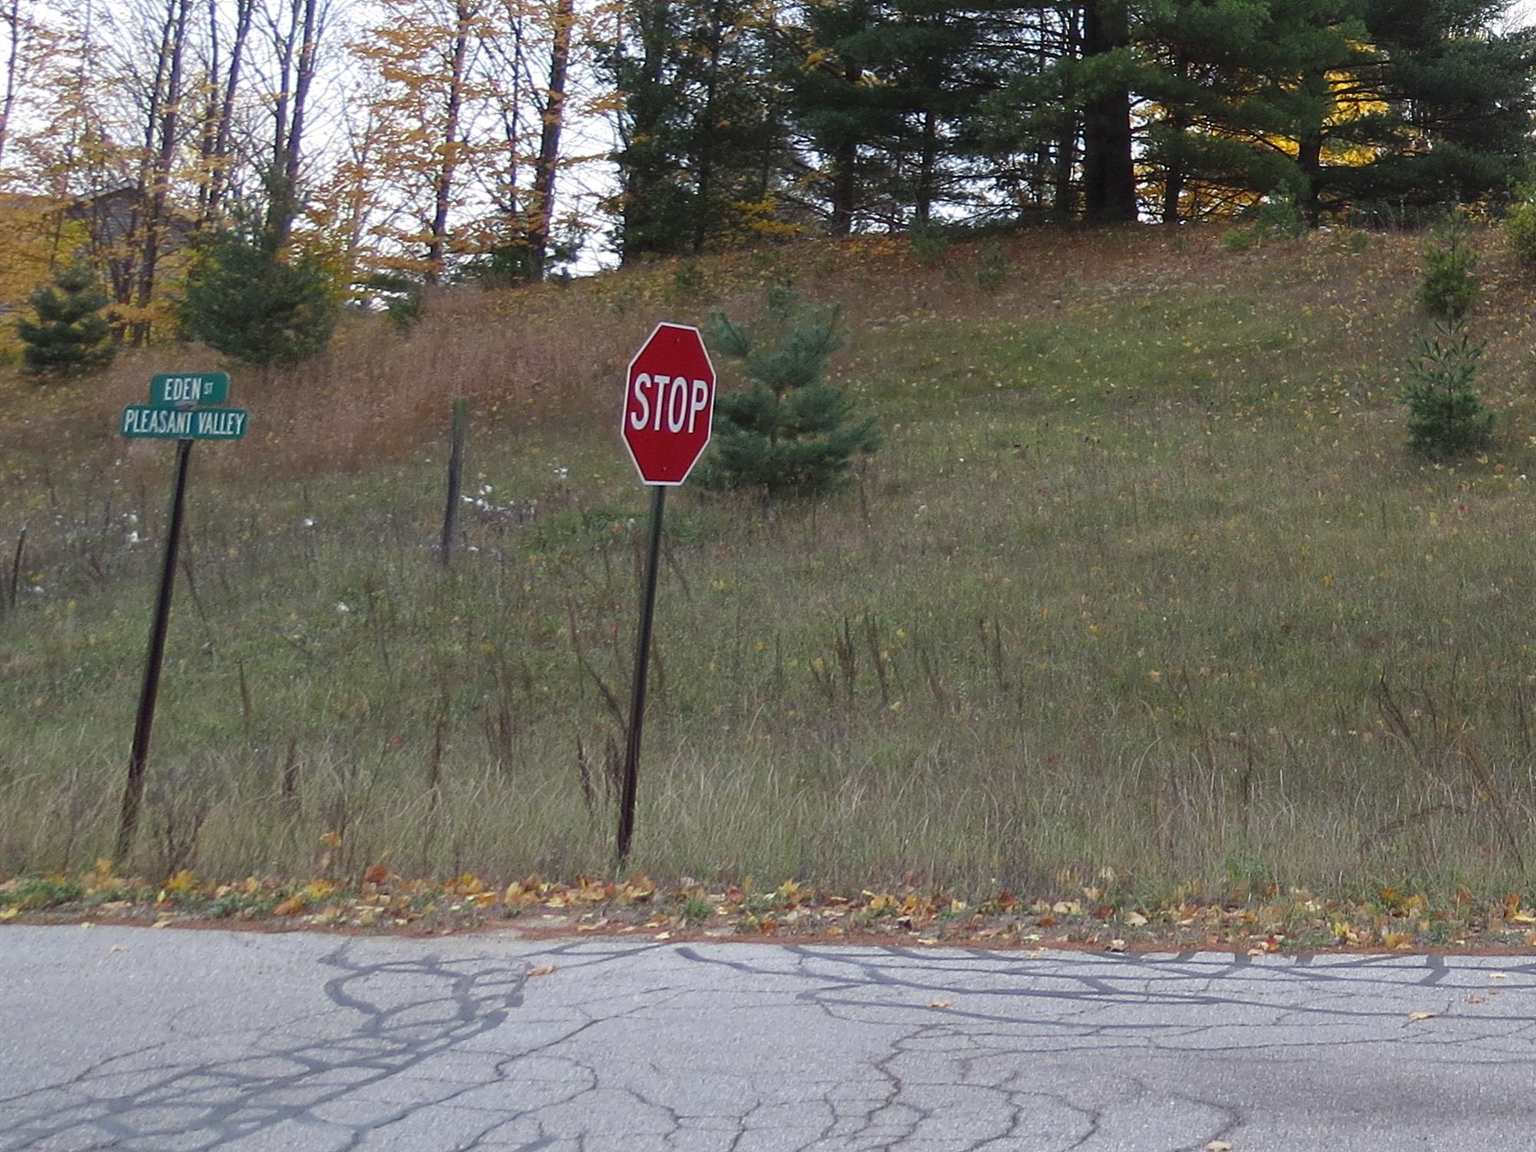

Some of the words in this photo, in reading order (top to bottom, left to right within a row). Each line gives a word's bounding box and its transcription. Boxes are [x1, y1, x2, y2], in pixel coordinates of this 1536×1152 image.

[165, 378, 202, 400] EDEN
[203, 383, 213, 395] ST
[630, 373, 709, 433] STOP
[124, 410, 193, 433] PLEASANT
[199, 412, 245, 434] VALLEY
